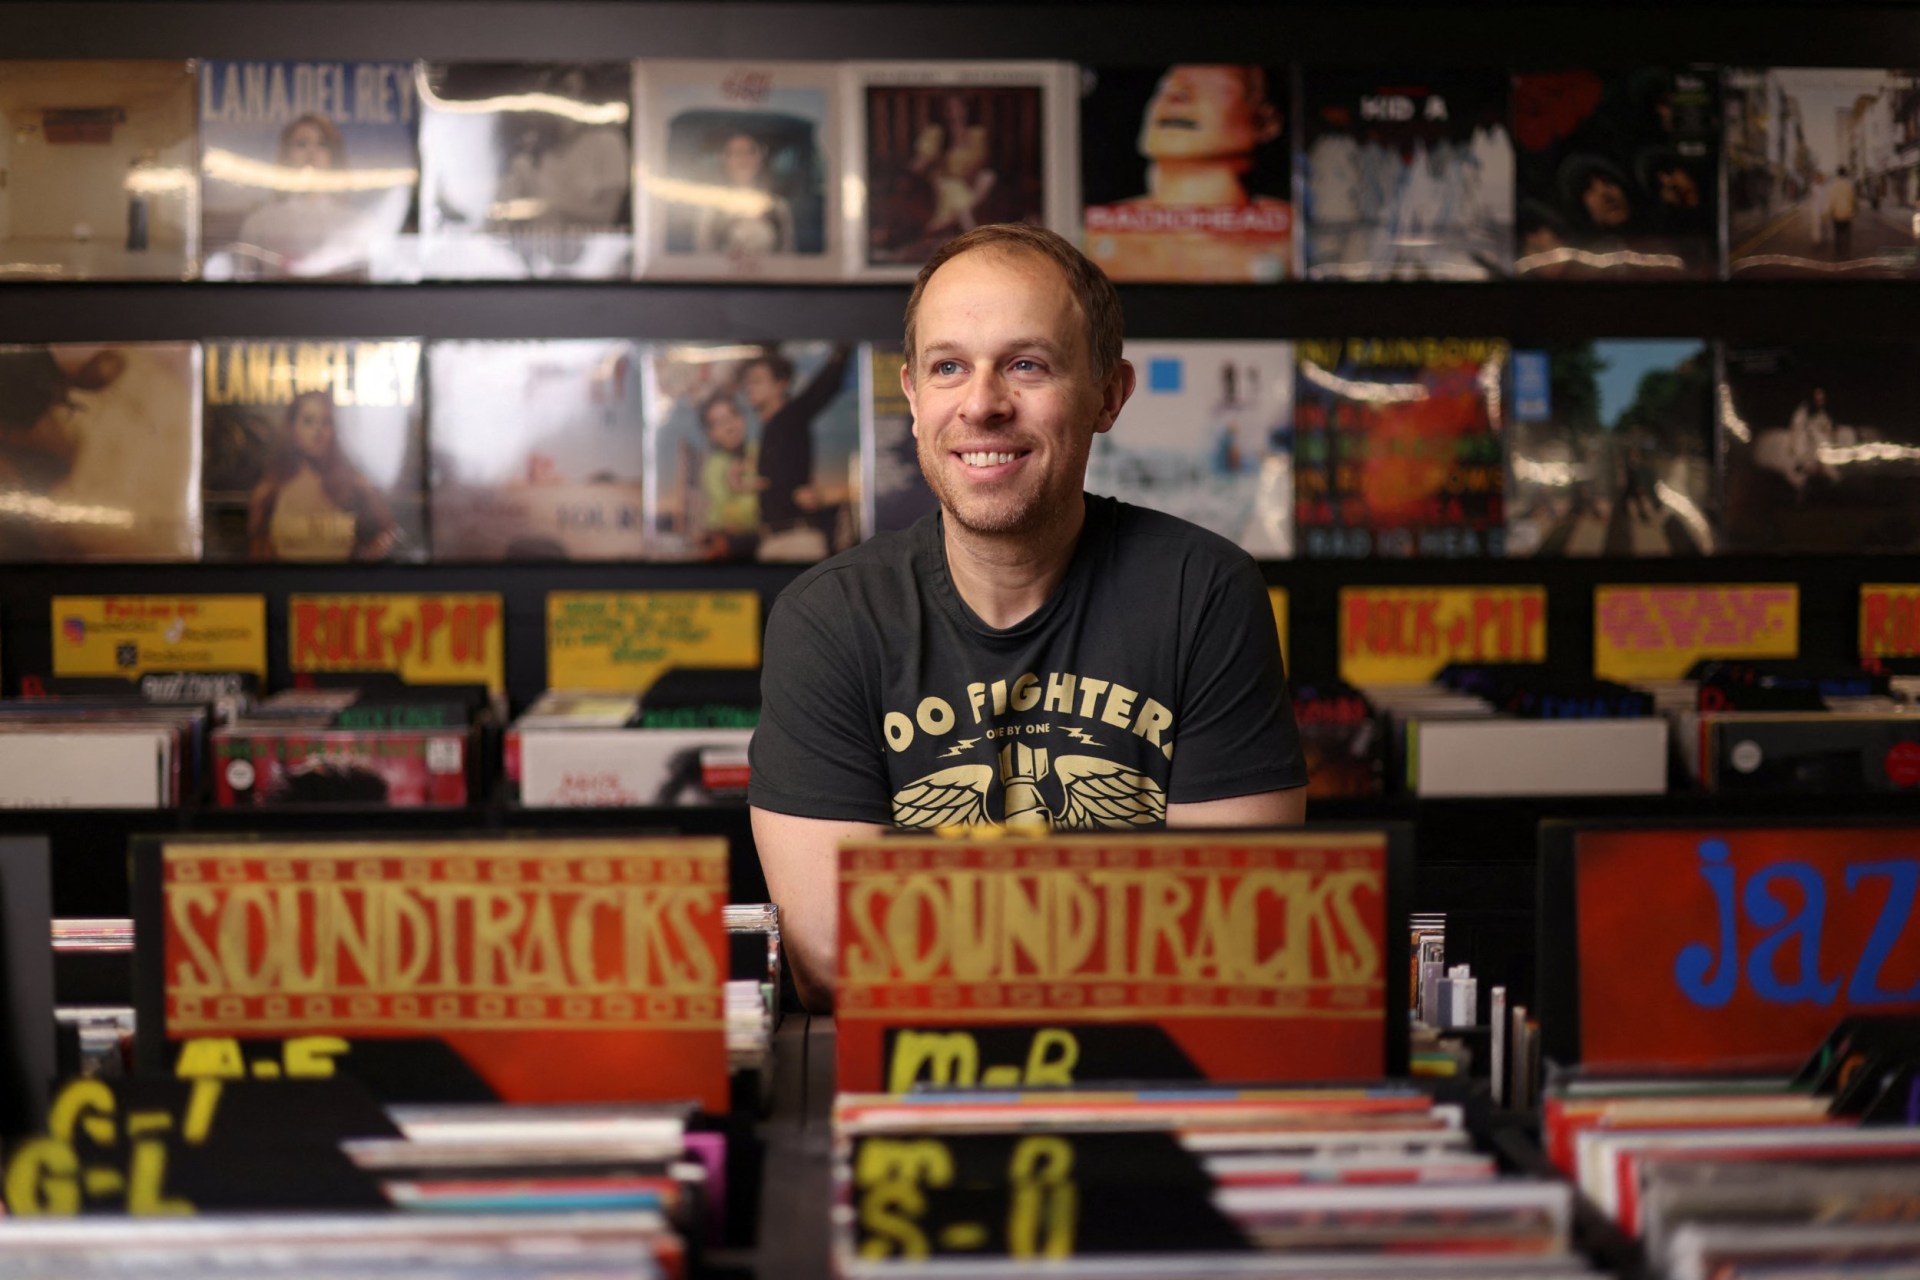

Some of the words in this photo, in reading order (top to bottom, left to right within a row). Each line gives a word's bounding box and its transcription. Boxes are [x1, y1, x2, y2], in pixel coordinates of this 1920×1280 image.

[203, 61, 291, 122] LANA
[293, 62, 350, 123] DEL
[355, 62, 412, 124] REY
[1361, 94, 1416, 121] KID
[1422, 94, 1449, 121] A
[1087, 203, 1289, 233] RADIOHEAD
[206, 340, 295, 405] LANA
[296, 600, 388, 663] ROCK
[421, 600, 496, 664] POP
[1347, 595, 1440, 657] ROCK
[1474, 593, 1543, 660] POP
[882, 696, 956, 752] OO
[967, 672, 1173, 761] FIGHTER
[1007, 725, 1021, 736] BY
[1025, 722, 1051, 735] ONE
[170, 884, 719, 993] SOUNDTRACKS
[846, 870, 1382, 985] SOUNDTRACKS
